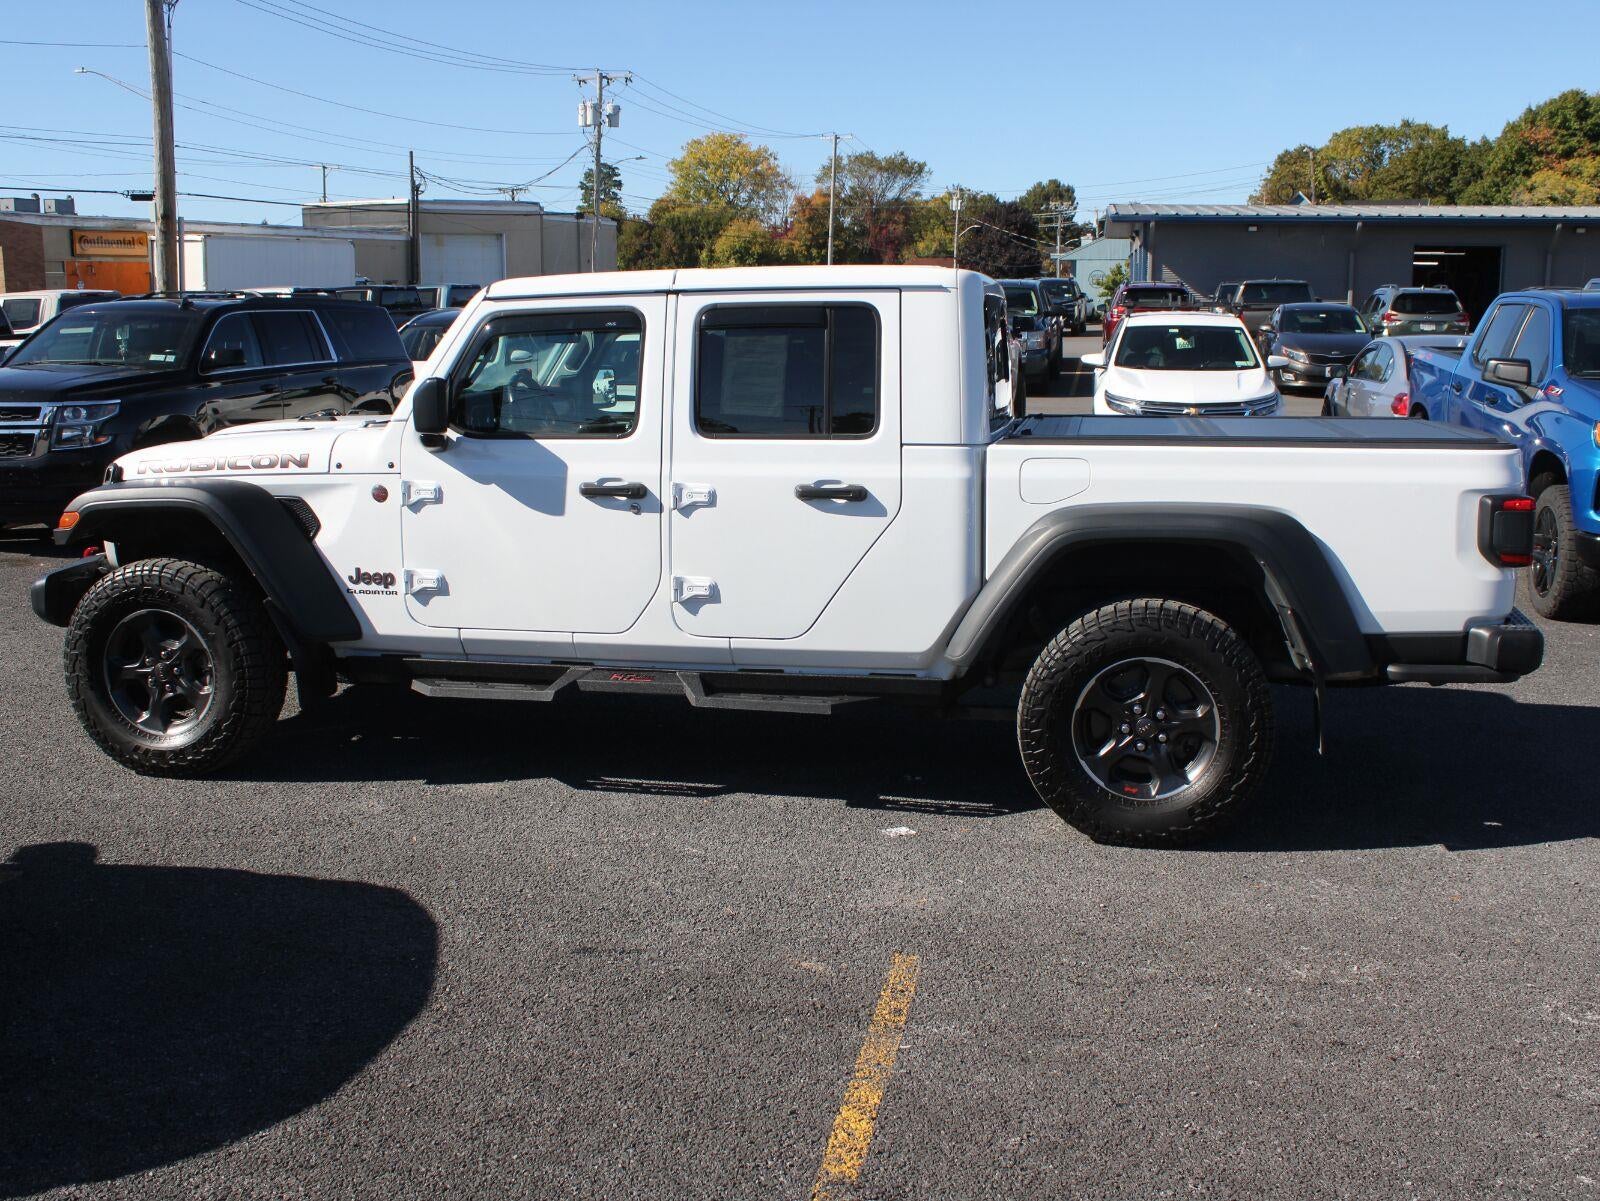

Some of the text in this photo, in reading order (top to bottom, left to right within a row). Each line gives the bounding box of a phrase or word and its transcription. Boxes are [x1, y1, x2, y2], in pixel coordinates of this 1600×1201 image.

[78, 234, 136, 250] Continental
[137, 453, 310, 475] RUBICON
[347, 567, 396, 589] Jeep
[346, 588, 398, 596] GLADIATOR
